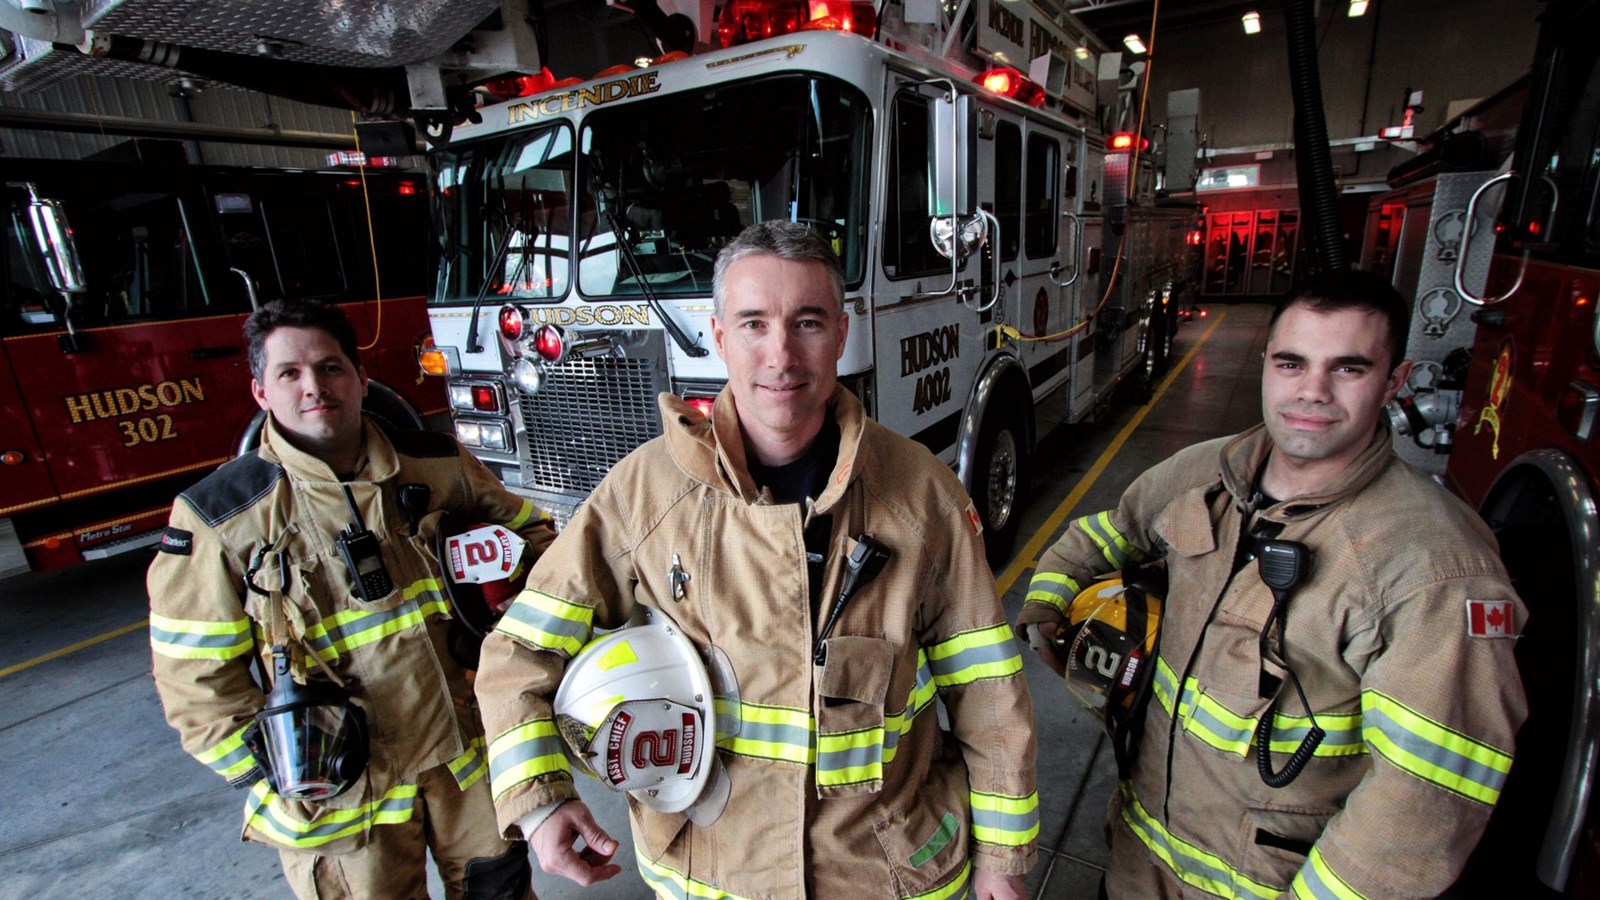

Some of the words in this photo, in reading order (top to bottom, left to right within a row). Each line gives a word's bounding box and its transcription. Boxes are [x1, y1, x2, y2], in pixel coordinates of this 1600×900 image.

[506, 70, 661, 125] INCENDIE
[528, 304, 650, 326] UDSON
[900, 323, 960, 378] HUDSON
[64, 377, 205, 424] HUDSON
[912, 366, 952, 416] 4002
[118, 413, 178, 448] 302
[80, 530, 111, 543] Metro
[112, 523, 133, 535] Star
[500, 534, 512, 563] CAPTAIN
[450, 546, 463, 573] HUDSON
[465, 539, 499, 567] 2
[1085, 645, 1122, 680] 2
[1121, 656, 1140, 687] HUDSON
[608, 716, 628, 751] CHIEF
[631, 728, 677, 769] 2
[681, 724, 694, 765] HUDSON
[607, 753, 624, 781] ASST.
